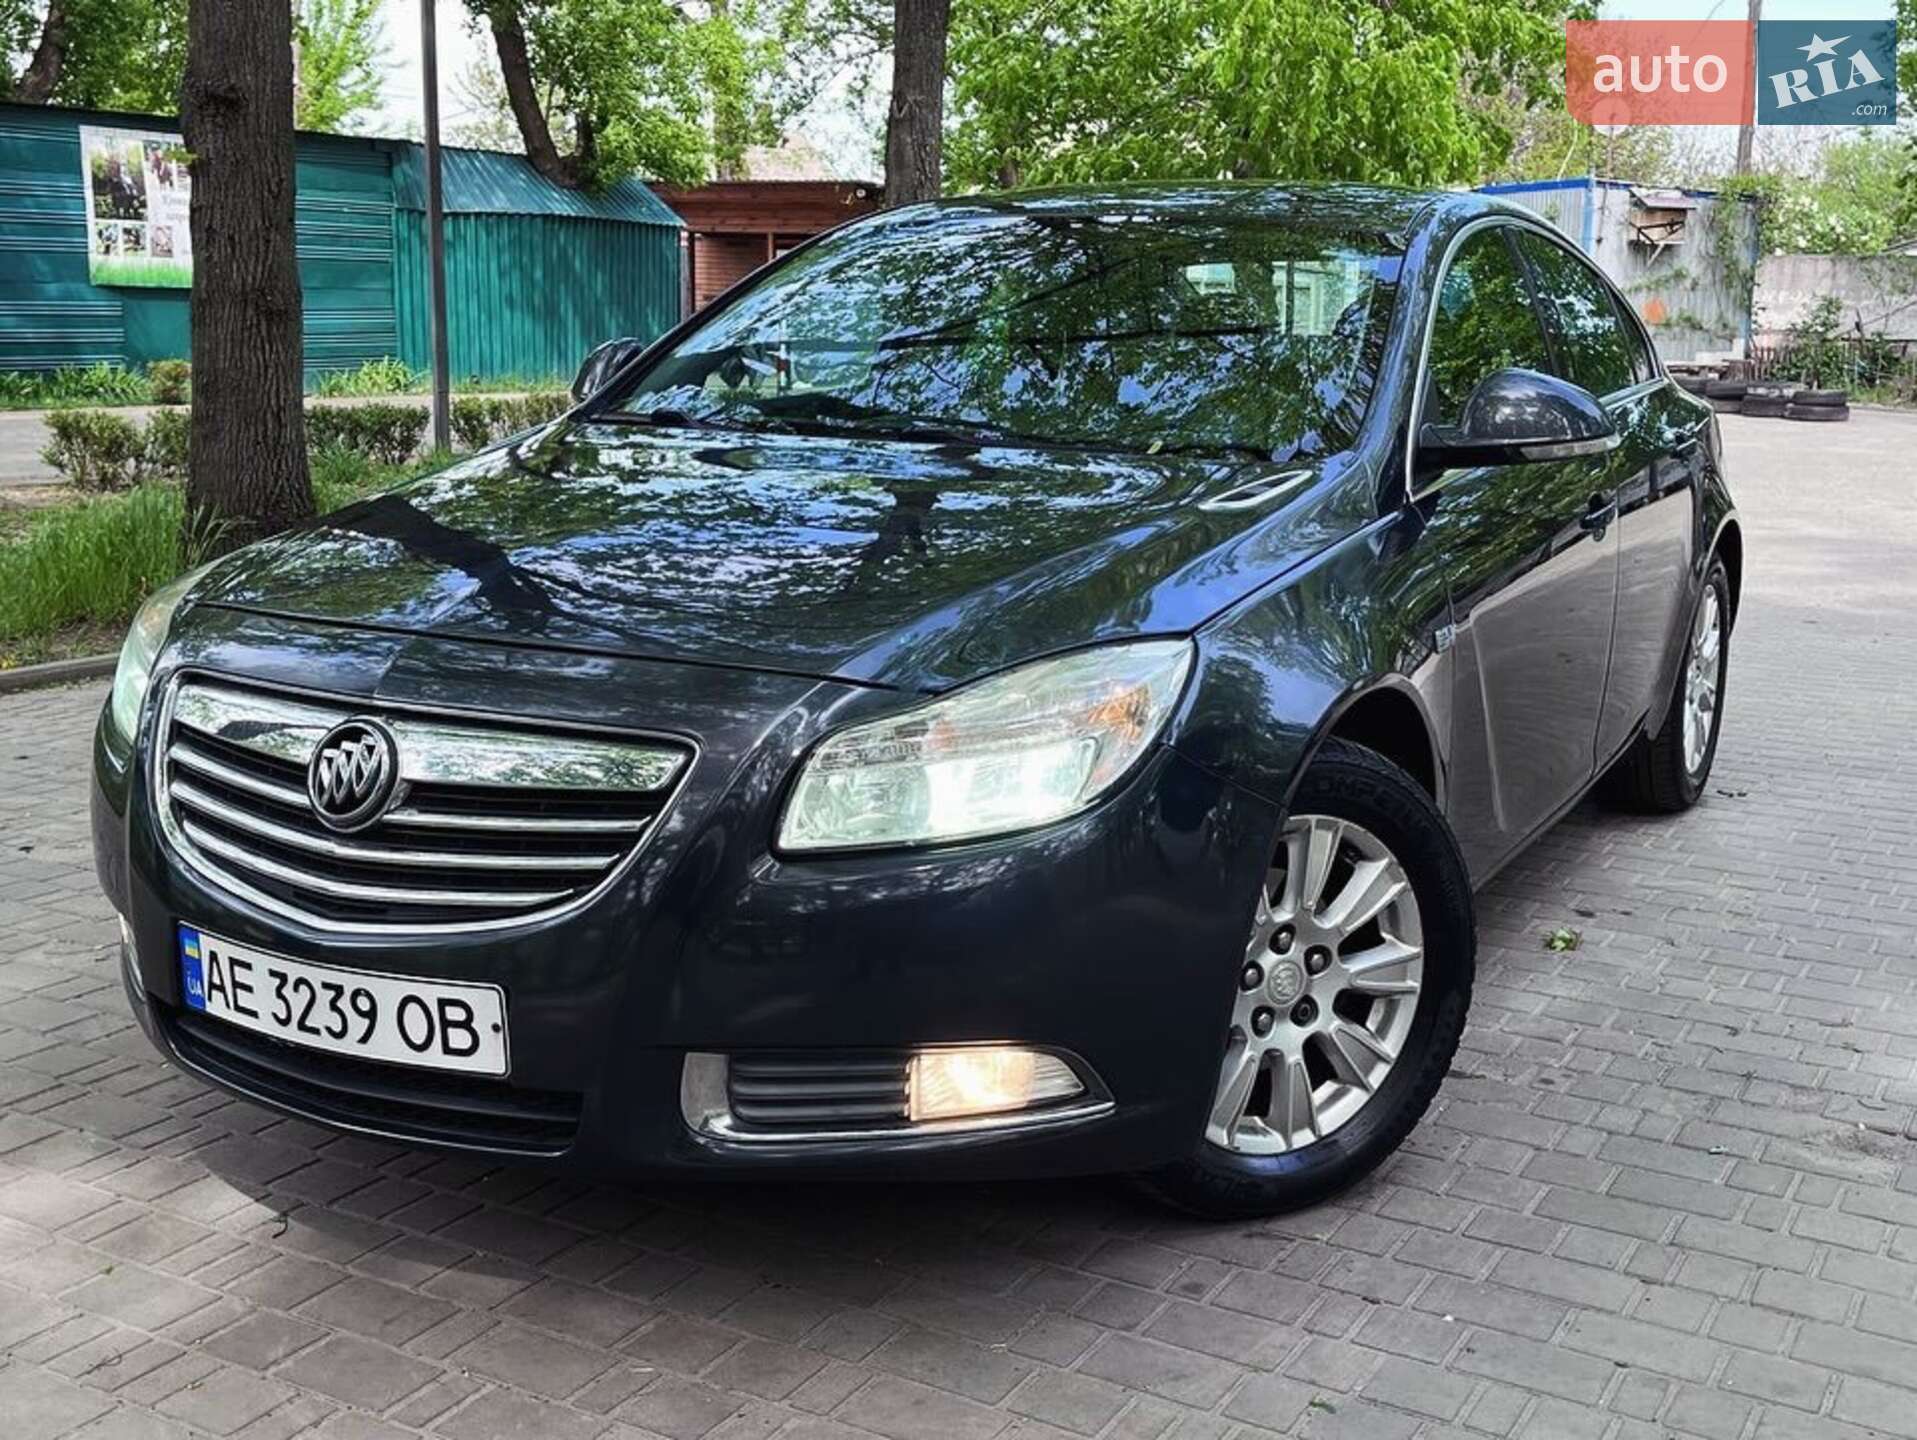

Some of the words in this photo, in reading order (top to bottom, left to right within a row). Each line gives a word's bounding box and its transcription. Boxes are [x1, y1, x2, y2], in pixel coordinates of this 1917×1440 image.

[207, 949, 259, 1019] AE
[267, 967, 379, 1046] 3239
[396, 994, 481, 1057] OB
